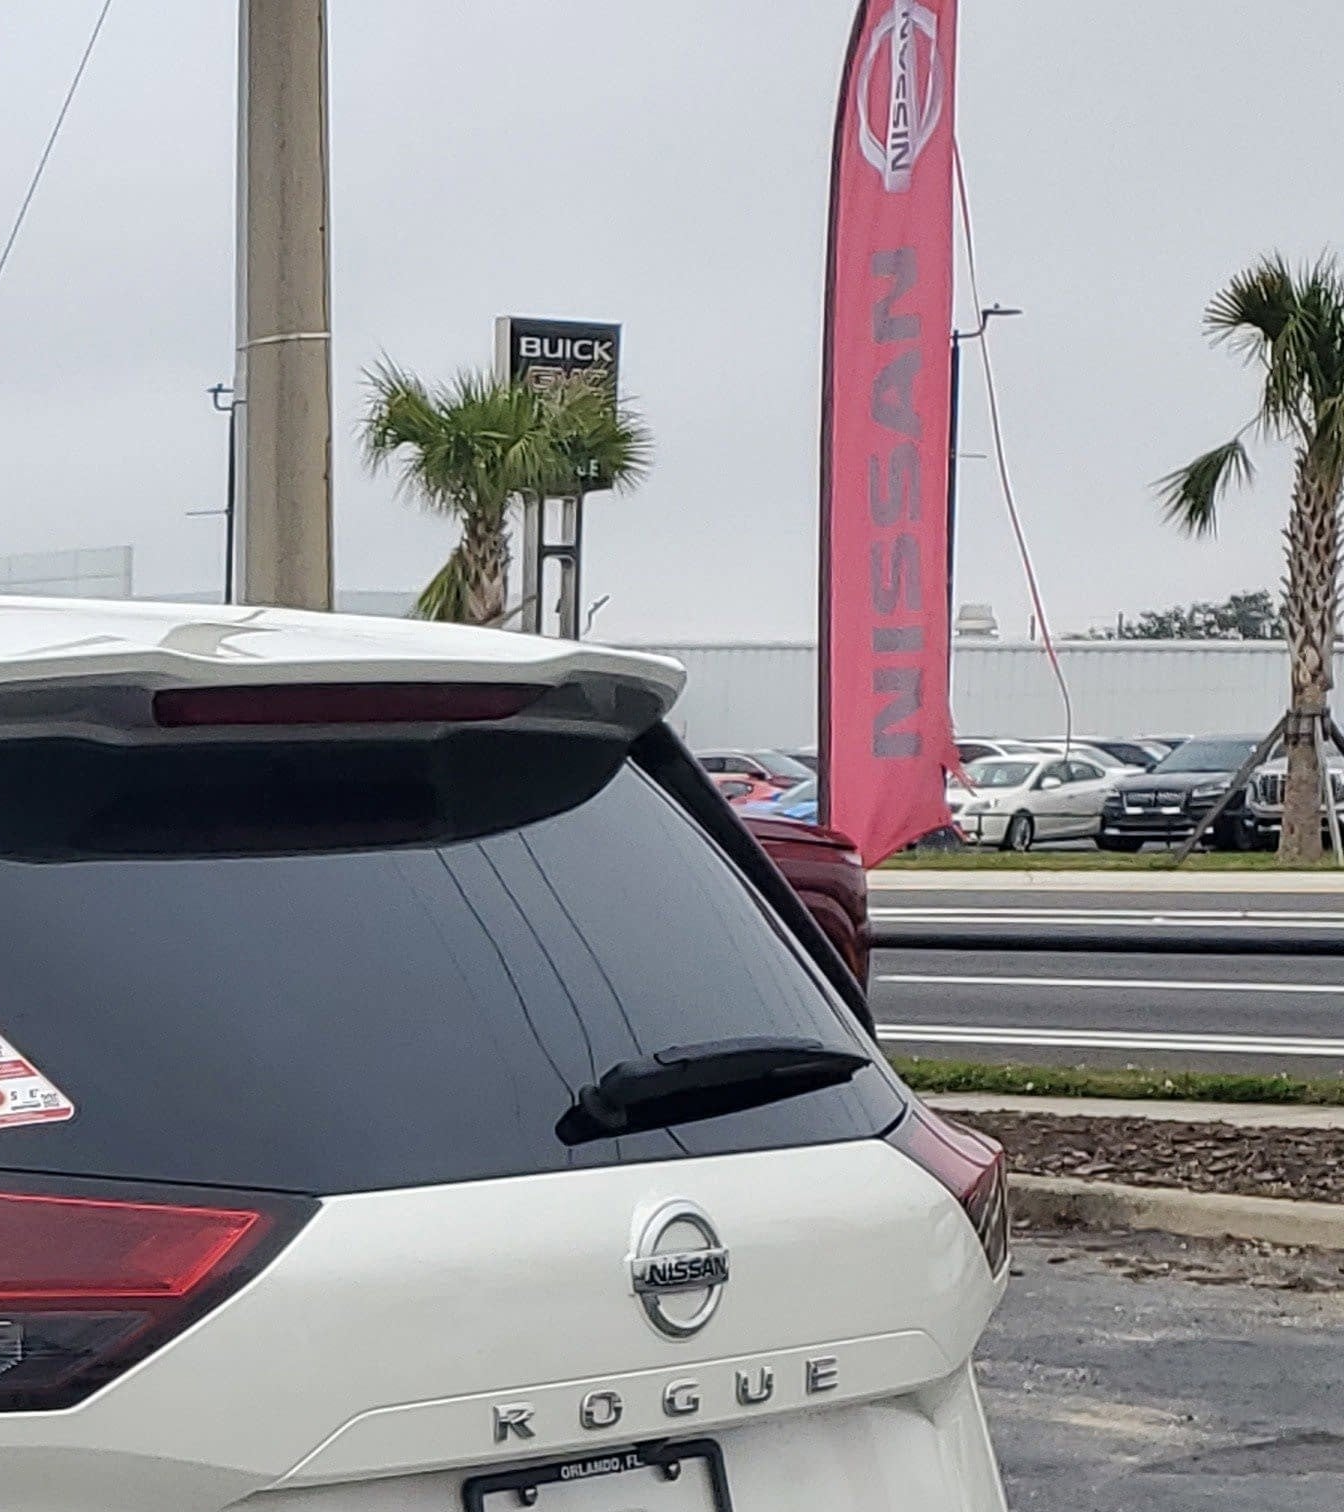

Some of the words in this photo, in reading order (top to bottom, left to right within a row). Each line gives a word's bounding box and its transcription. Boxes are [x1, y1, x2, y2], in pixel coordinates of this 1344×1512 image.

[519, 336, 612, 362] BUICK
[868, 245, 925, 760] NISSAN
[644, 1256, 728, 1285] NISSAN
[492, 1356, 840, 1444] ROGUE
[561, 1457, 624, 1479] ORLANDO,
[626, 1454, 645, 1468] FL
